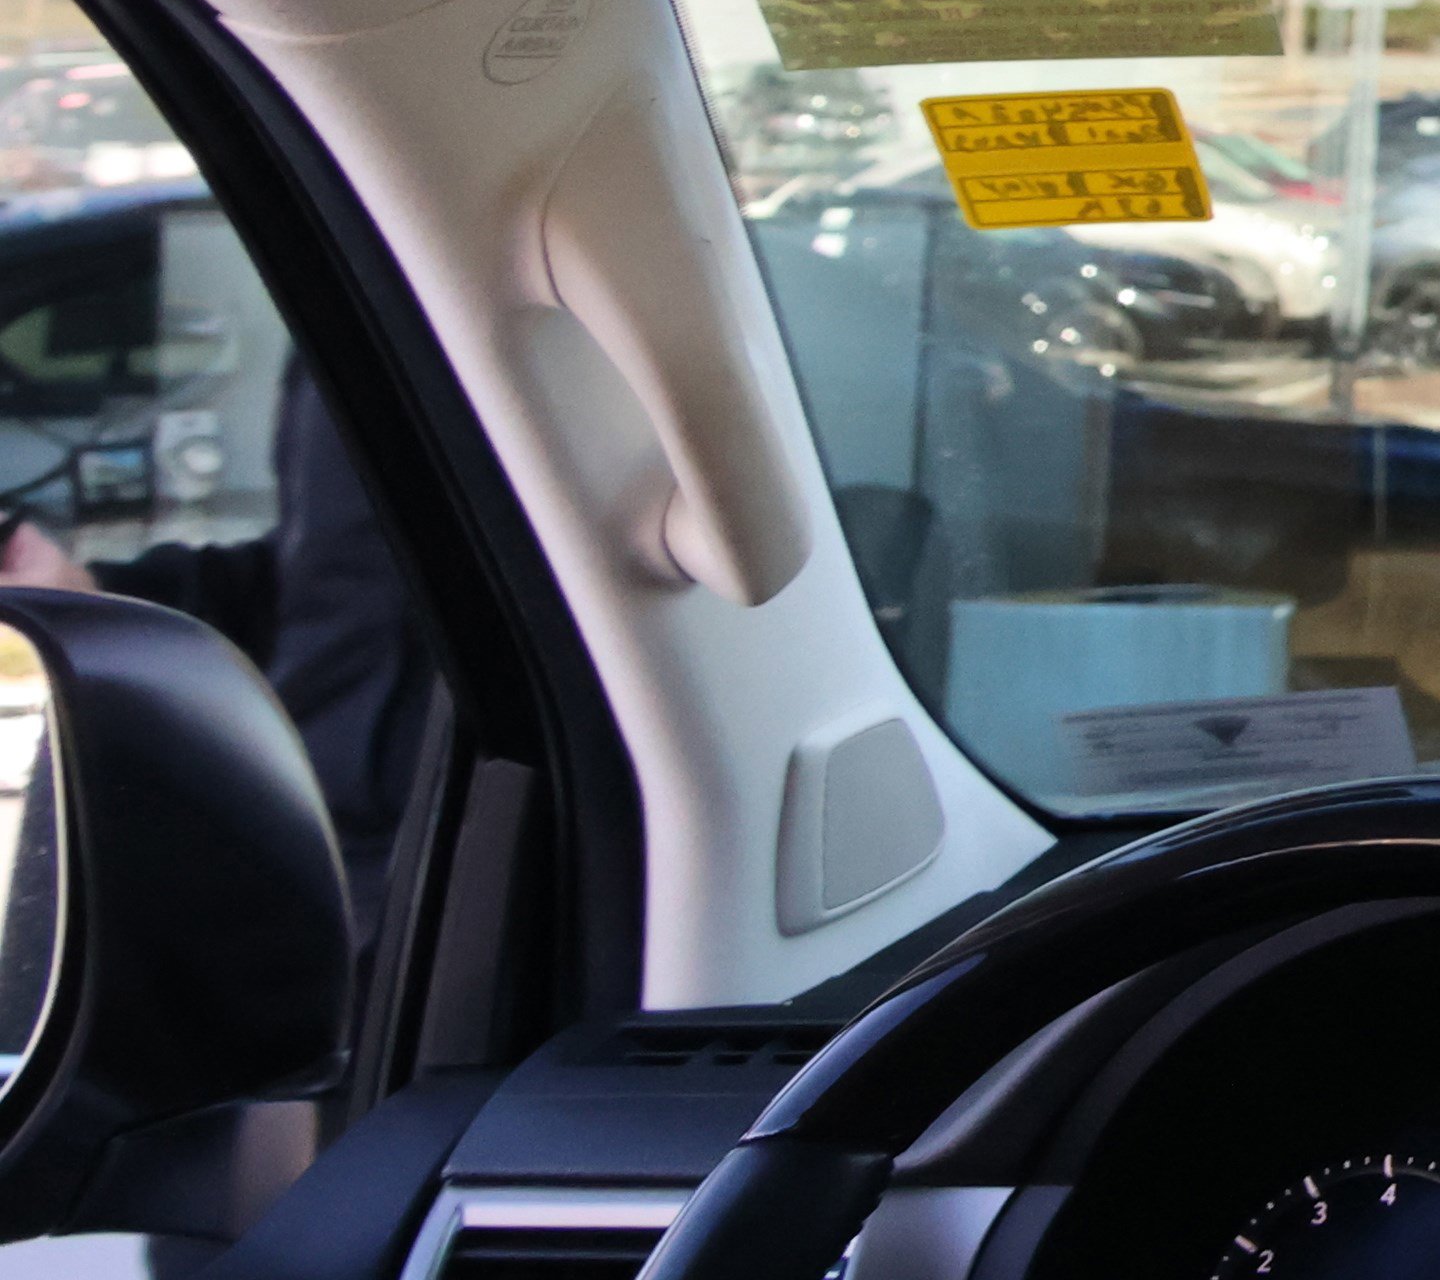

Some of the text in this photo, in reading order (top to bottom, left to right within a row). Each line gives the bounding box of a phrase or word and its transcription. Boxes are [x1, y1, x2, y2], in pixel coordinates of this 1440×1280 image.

[1380, 1182, 1397, 1207] 4
[1310, 1201, 1329, 1226] 3
[1256, 1249, 1275, 1274] 2
